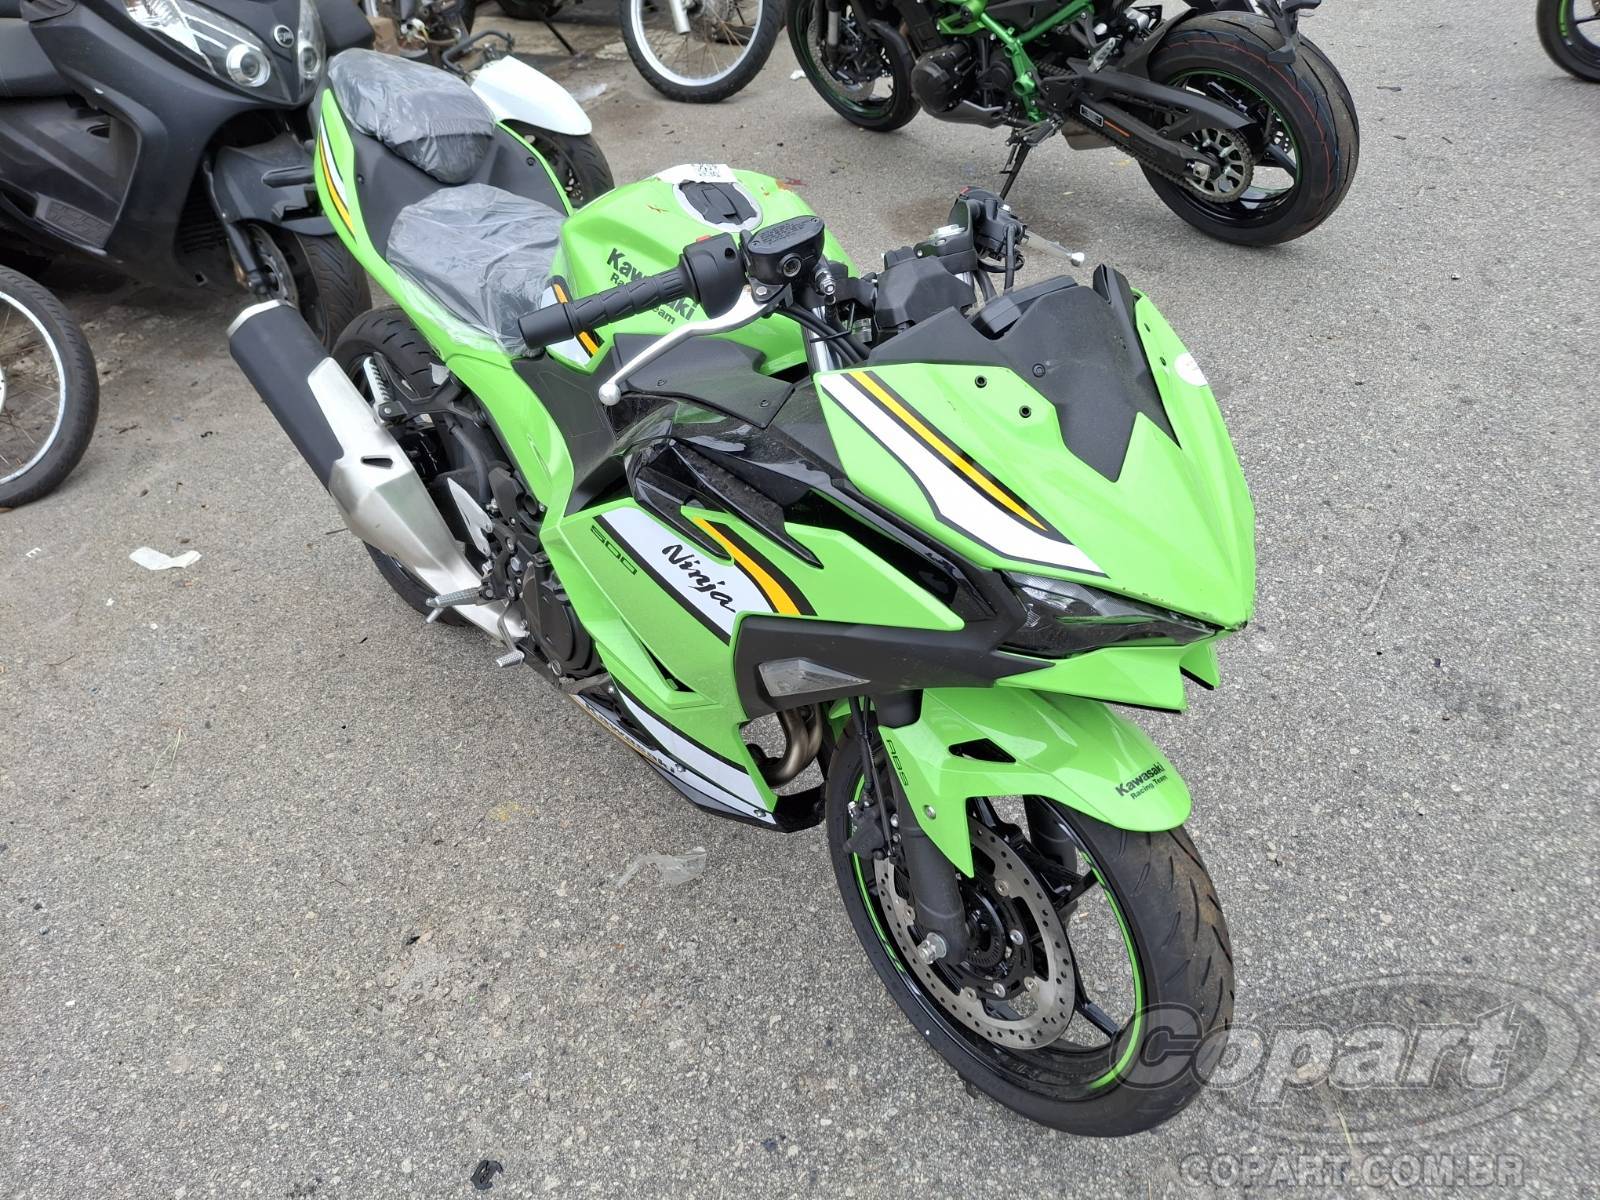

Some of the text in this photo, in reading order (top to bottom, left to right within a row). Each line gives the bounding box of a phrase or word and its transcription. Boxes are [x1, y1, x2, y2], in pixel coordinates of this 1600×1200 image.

[590, 525, 638, 576] 500
[661, 544, 737, 613] Ninja
[886, 739, 909, 787] ABS
[1114, 761, 1167, 797] Kawasaki
[1129, 773, 1168, 800] Racing Team
